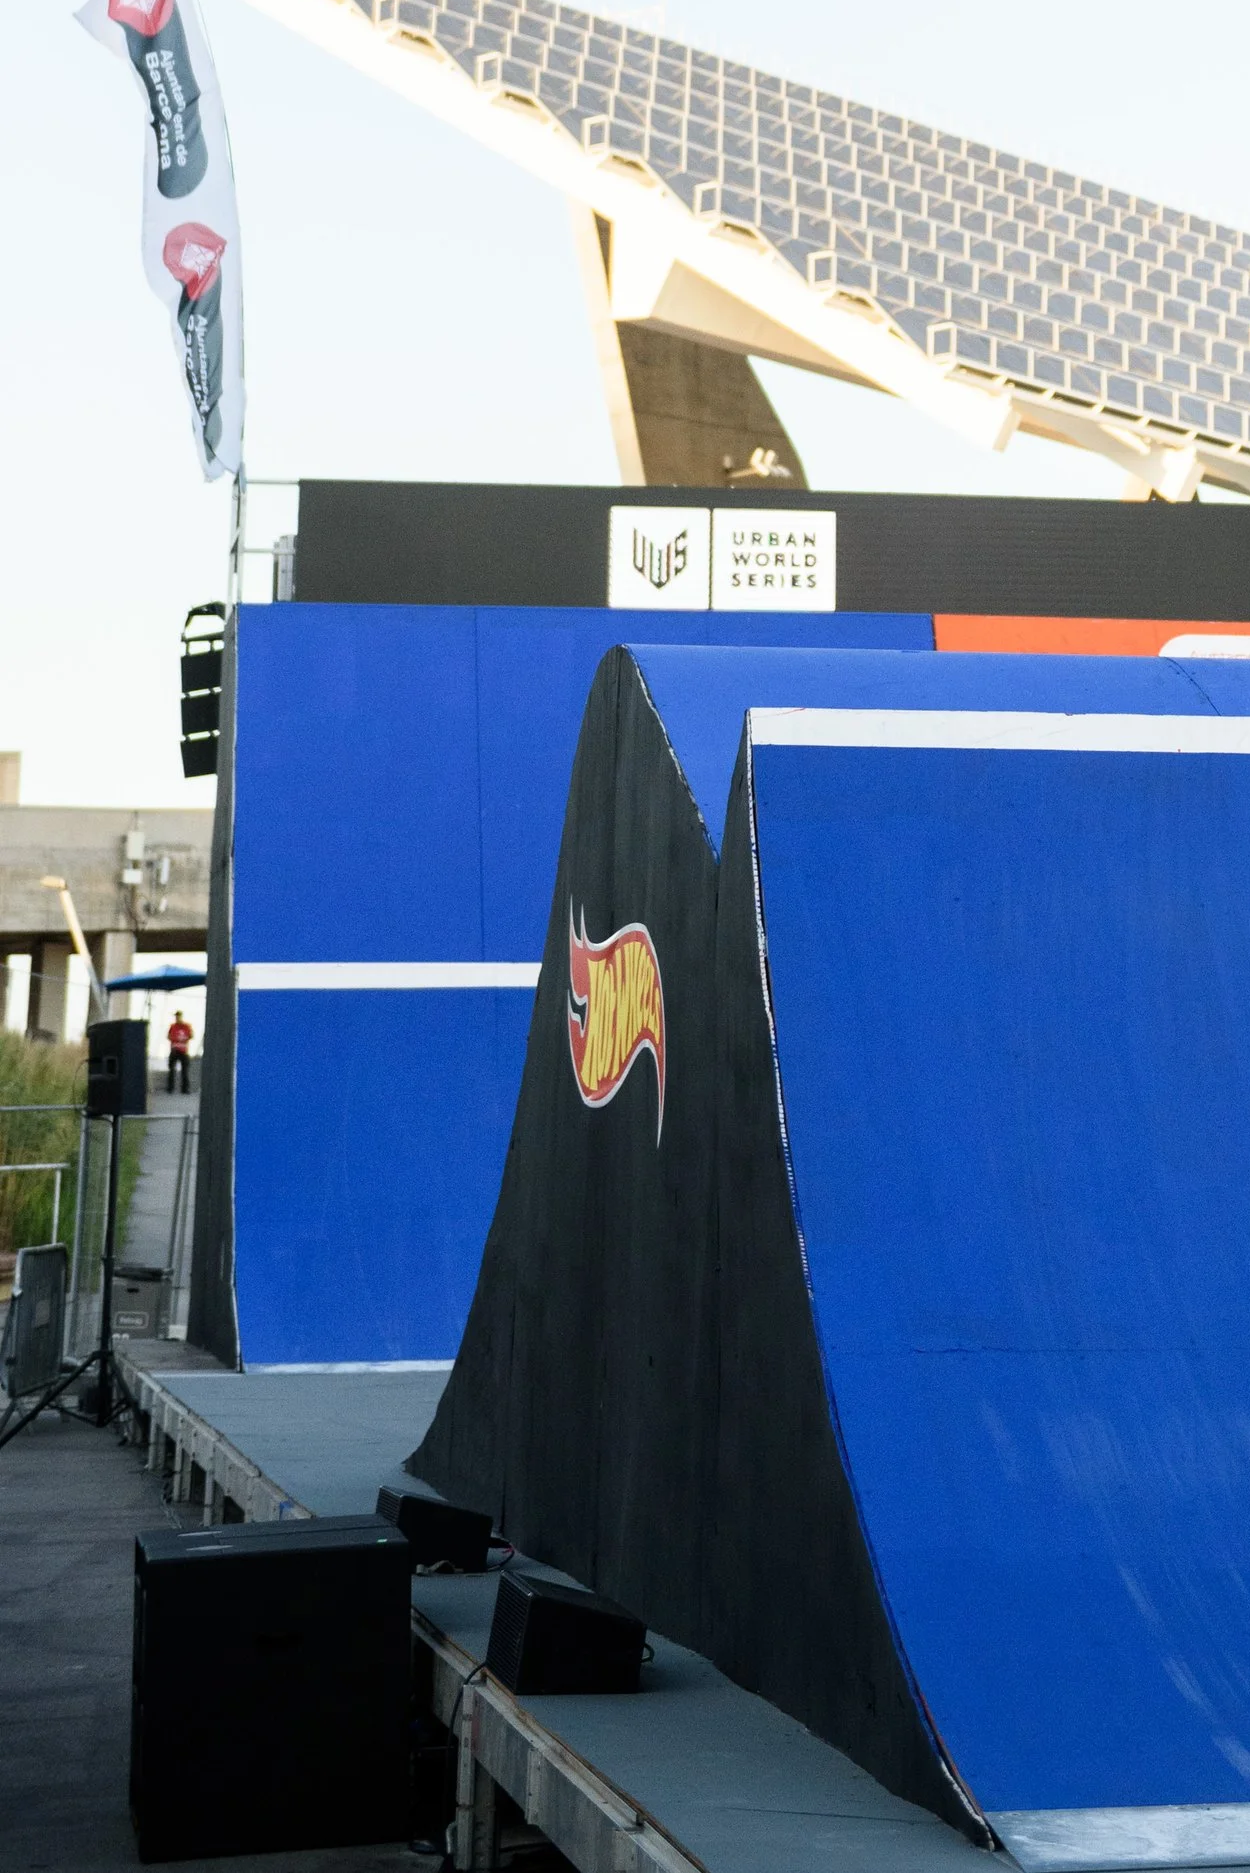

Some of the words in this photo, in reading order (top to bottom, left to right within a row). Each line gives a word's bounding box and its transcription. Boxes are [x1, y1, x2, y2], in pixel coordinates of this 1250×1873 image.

[145, 51, 172, 170] Barceona
[176, 143, 188, 167] de
[732, 531, 816, 547] URBAN
[732, 552, 817, 568] WORLD
[731, 573, 817, 589] SERIES
